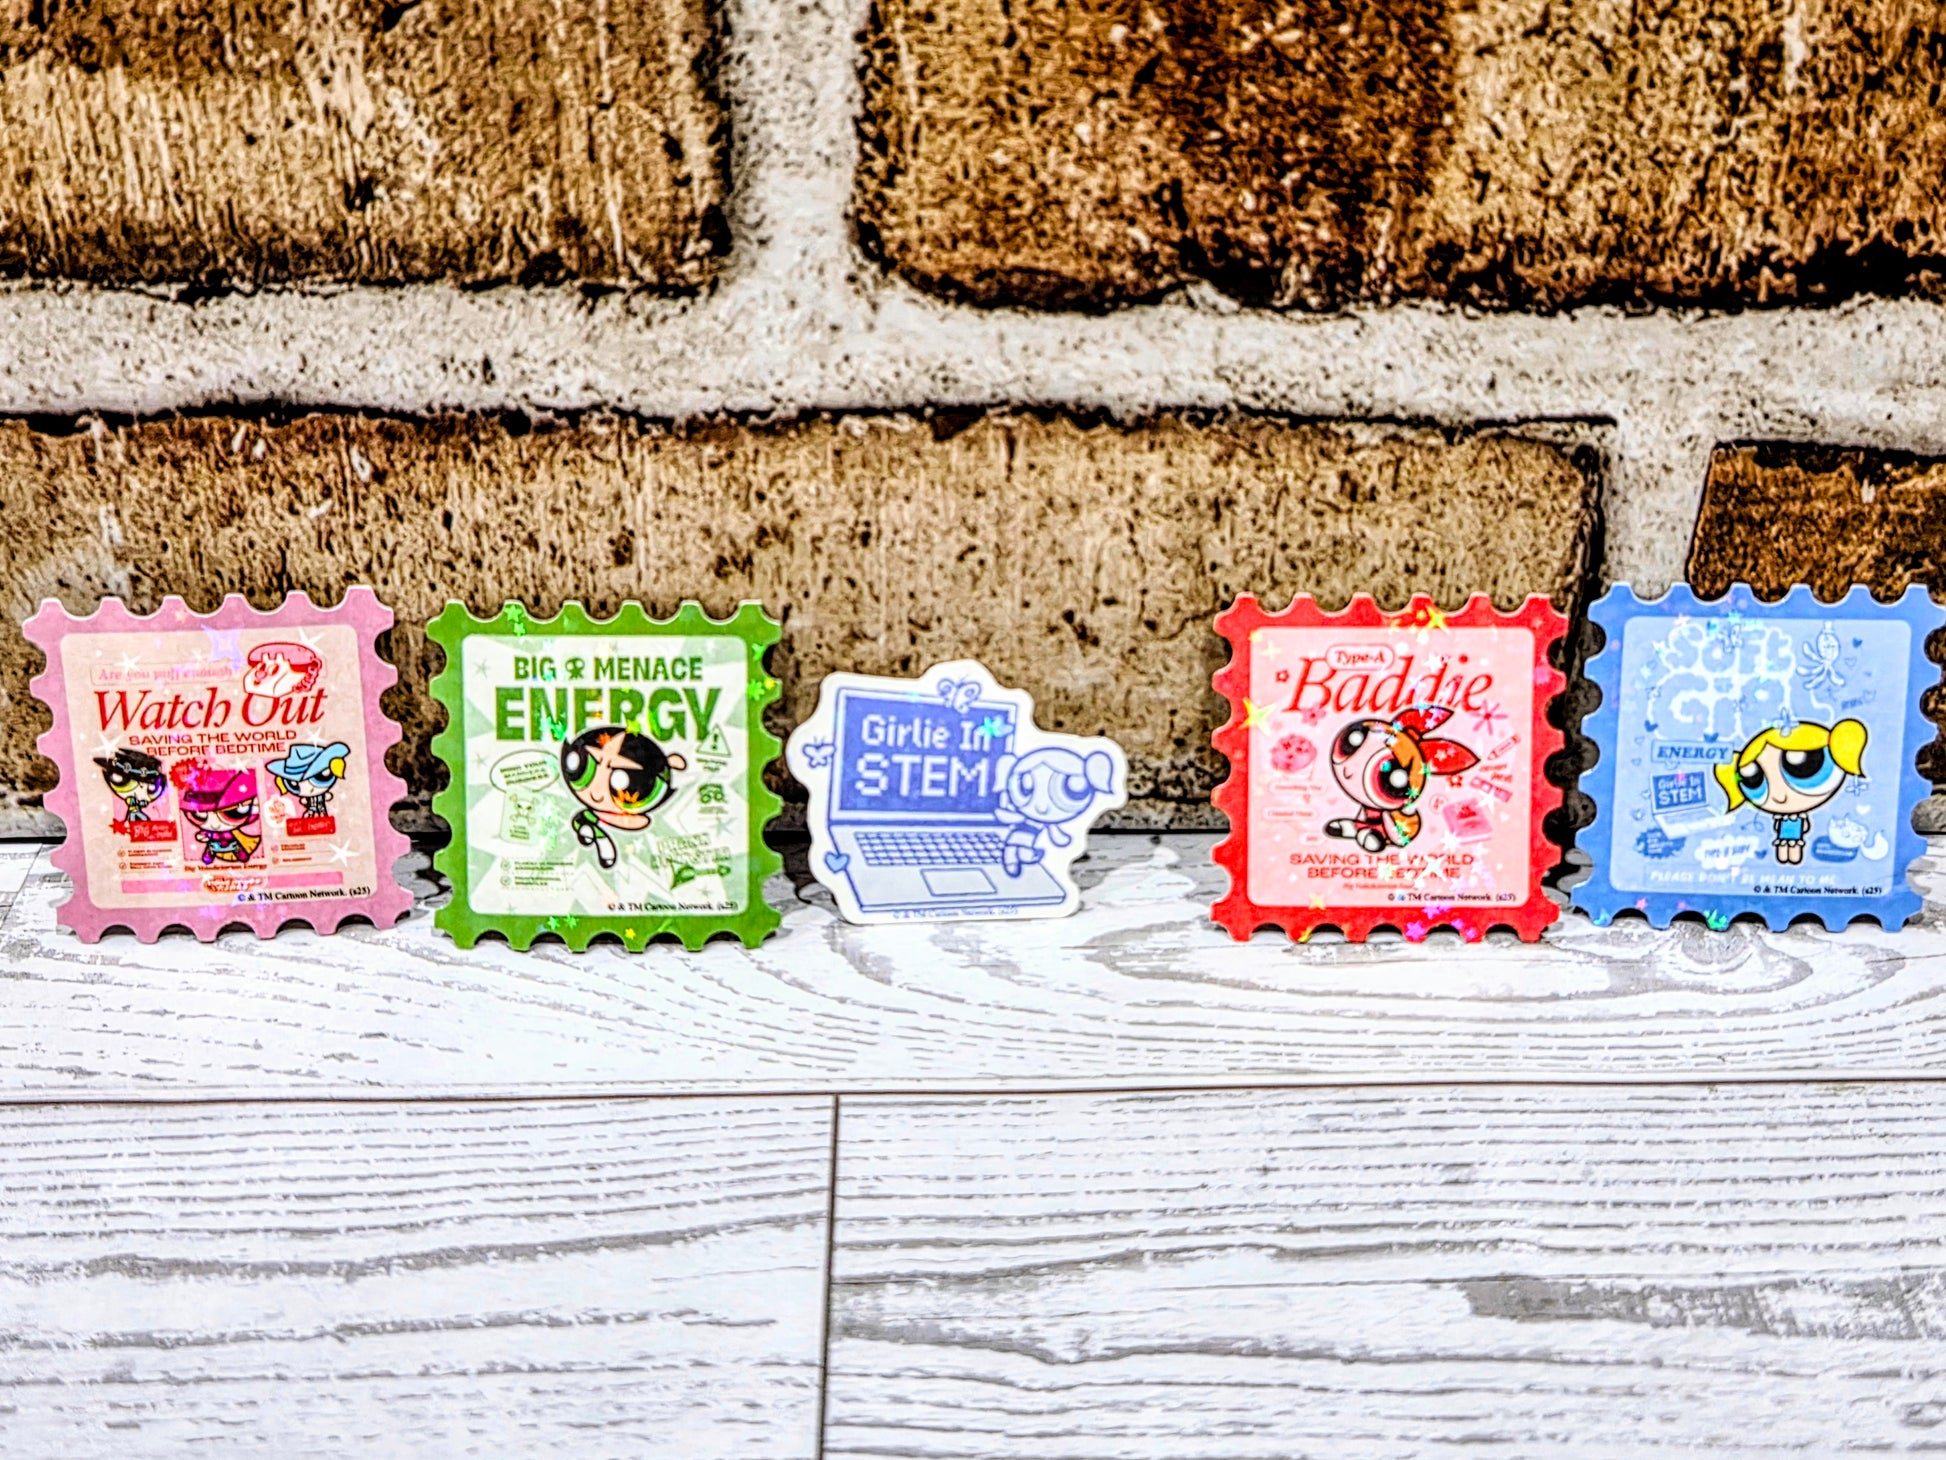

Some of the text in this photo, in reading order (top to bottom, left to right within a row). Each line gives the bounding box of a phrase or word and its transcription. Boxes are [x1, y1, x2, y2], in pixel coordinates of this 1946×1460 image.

[1336, 650, 1385, 664] Type-A
[514, 656, 703, 681] BIG MENACE
[1282, 655, 1494, 713] Baddie
[94, 686, 328, 731] Watch Out
[495, 686, 723, 741] ENERGY
[129, 730, 297, 745] SAVING THE WORLD
[862, 714, 992, 752] Girlie In
[146, 742, 286, 756] BEFORE BEDTIME
[1656, 745, 1729, 760] ENERGY
[855, 753, 989, 798] STEM
[1658, 785, 1703, 805] STEM
[1290, 854, 1360, 865] SAVING
[1366, 854, 1400, 865] THE
[1308, 867, 1378, 878] BEFORE
[1650, 871, 1694, 882] PLEASE
[1741, 873, 1755, 884] BE
[1760, 874, 1794, 885] MEAN
[1800, 874, 1815, 885] TO
[1818, 875, 1836, 885] ME
[258, 892, 272, 901] TM
[275, 890, 308, 900] Cartoon
[1408, 893, 1421, 901] TM
[1424, 893, 1455, 901] Cartoon
[1774, 885, 1788, 894] TM
[1790, 885, 1822, 895] Cartoon
[628, 902, 642, 911] TM
